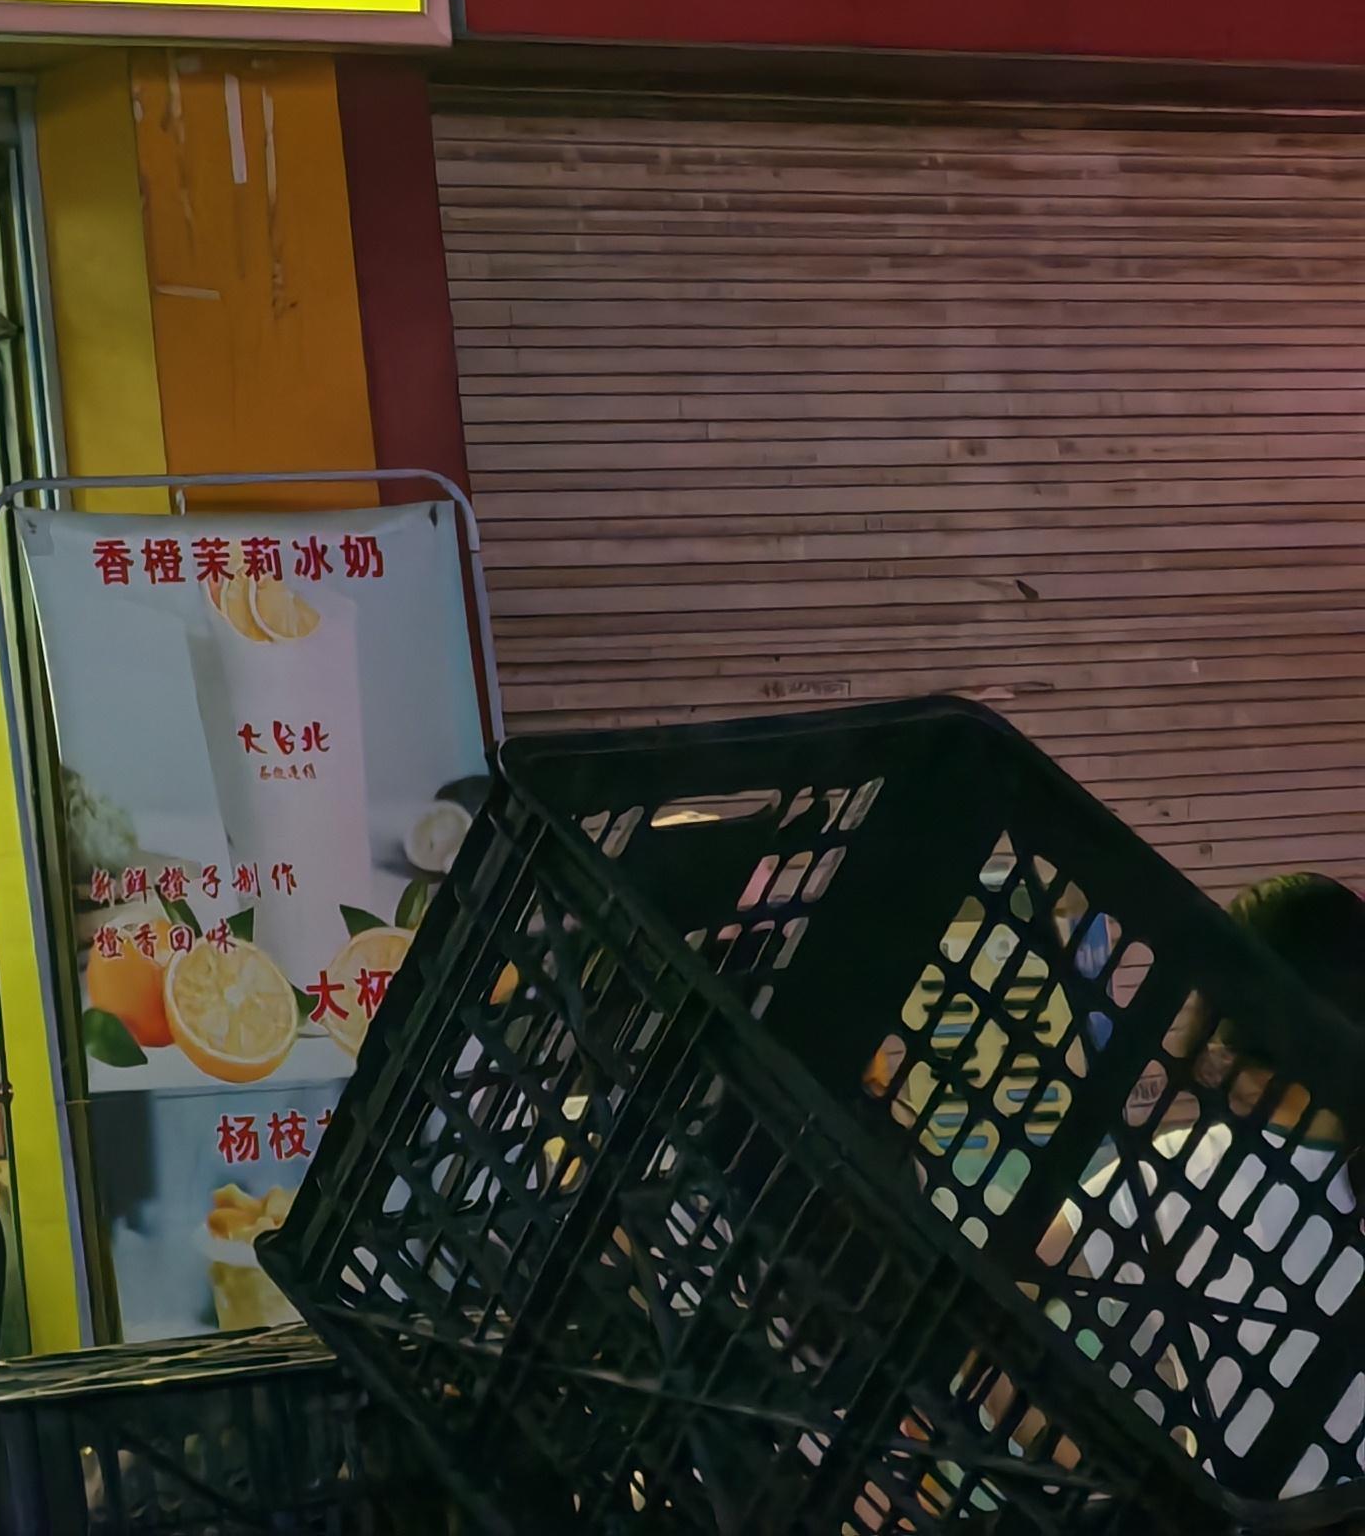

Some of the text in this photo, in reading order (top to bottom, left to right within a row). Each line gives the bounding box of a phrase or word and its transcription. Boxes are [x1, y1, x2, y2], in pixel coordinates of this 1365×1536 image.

[92, 535, 384, 585] 香橙茉莉冰奶
[237, 720, 331, 755] 大台北
[90, 863, 297, 906] 新鲜橙子制作
[94, 918, 237, 958] 橙香回味
